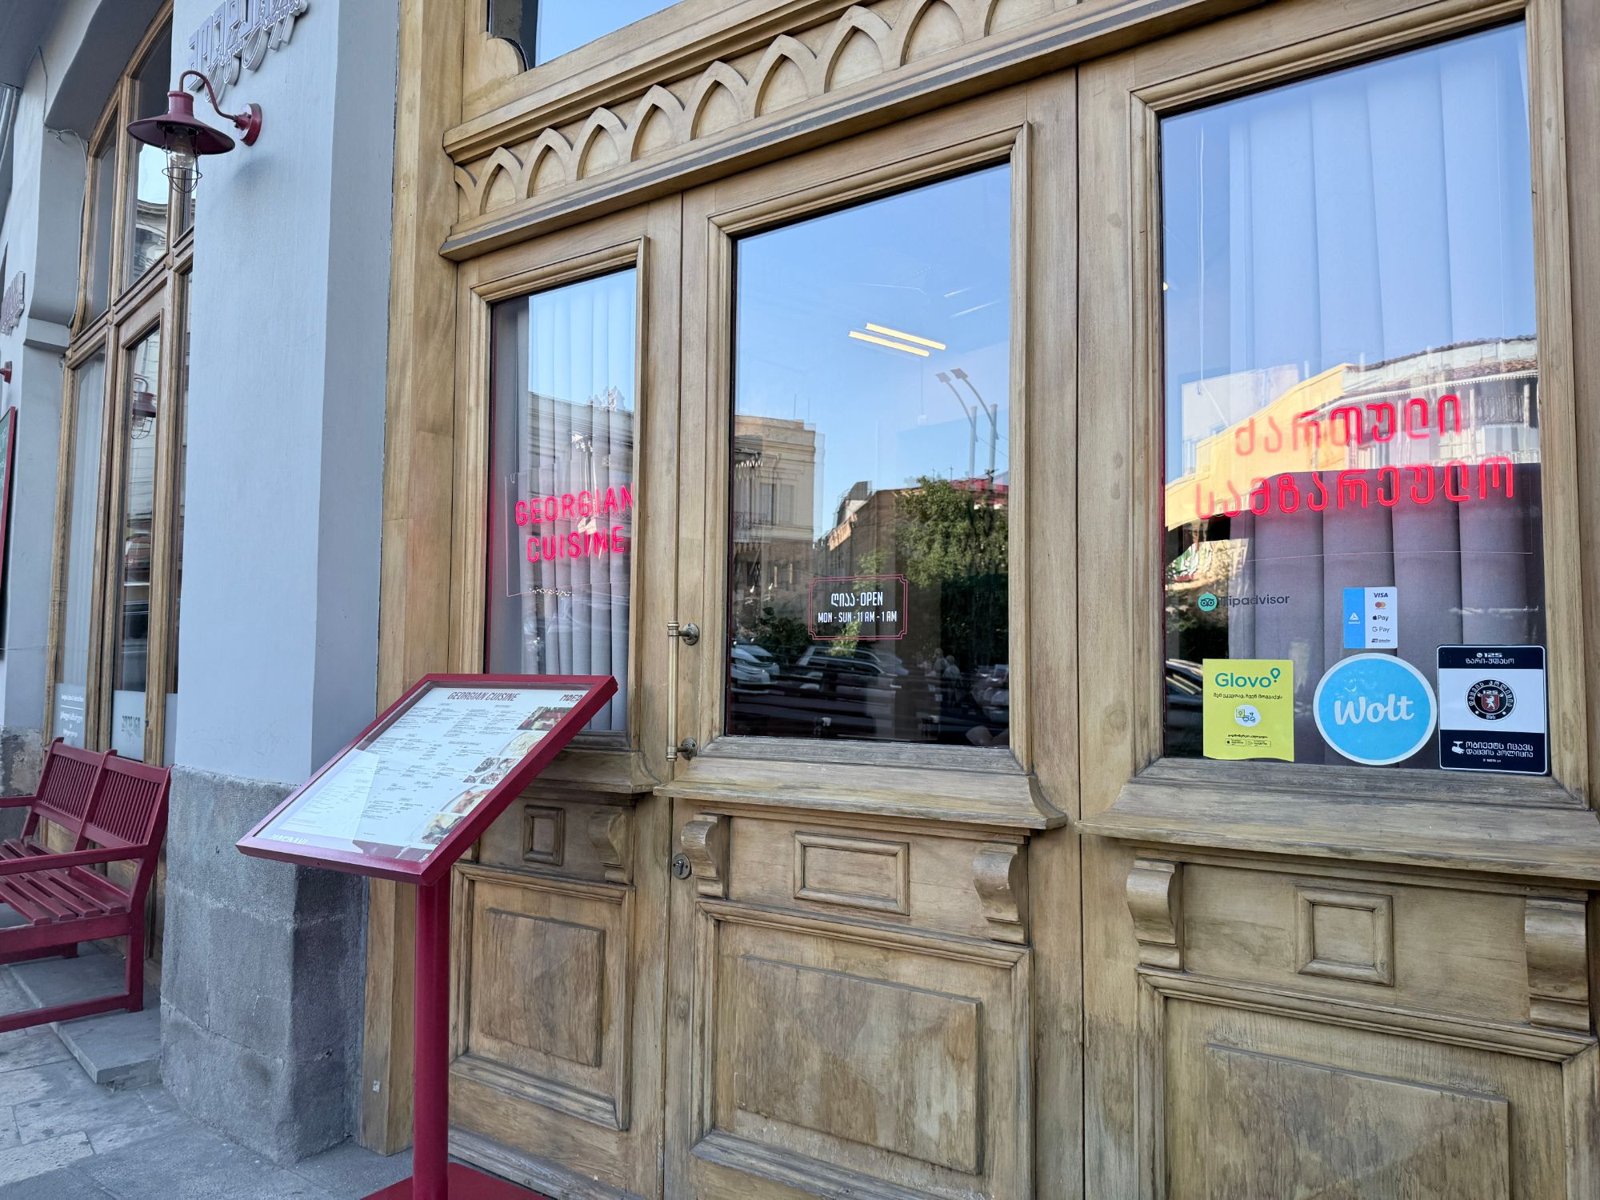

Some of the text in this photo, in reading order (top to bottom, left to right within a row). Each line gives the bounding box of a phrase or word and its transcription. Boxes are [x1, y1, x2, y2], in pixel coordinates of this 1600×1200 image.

[1234, 393, 1462, 457] ქართული
[515, 482, 635, 526] GEORGIAN
[1195, 455, 1515, 520] სამზარეულო
[527, 525, 625, 563] CUISINE
[860, 591, 884, 606] OPEN
[817, 612, 833, 623] MON
[838, 611, 852, 623] SUN
[864, 611, 875, 623] AM
[886, 610, 897, 622] AM
[1214, 672, 1272, 688] Glovo
[1334, 693, 1415, 726] Wolt
